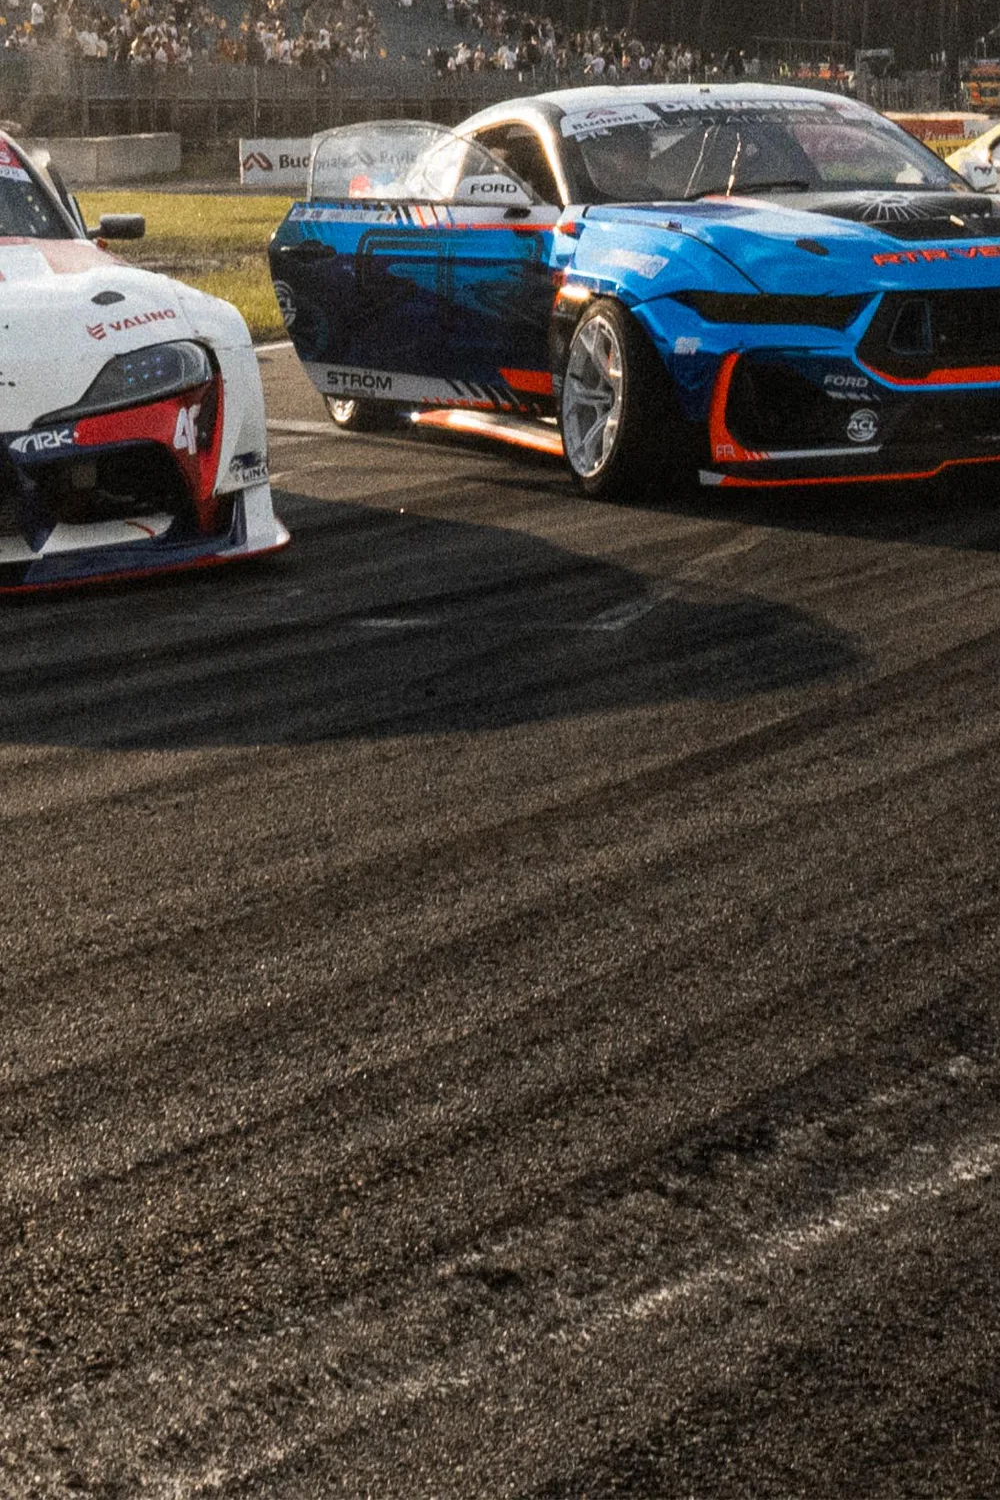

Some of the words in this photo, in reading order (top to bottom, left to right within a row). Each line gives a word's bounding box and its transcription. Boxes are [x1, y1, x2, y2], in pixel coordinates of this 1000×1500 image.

[470, 183, 518, 195] FORD
[872, 249, 950, 266] RTR
[108, 309, 177, 331] VALINO
[327, 370, 392, 391] STRÖM
[823, 374, 869, 388] FORD
[846, 419, 878, 432] ACL
